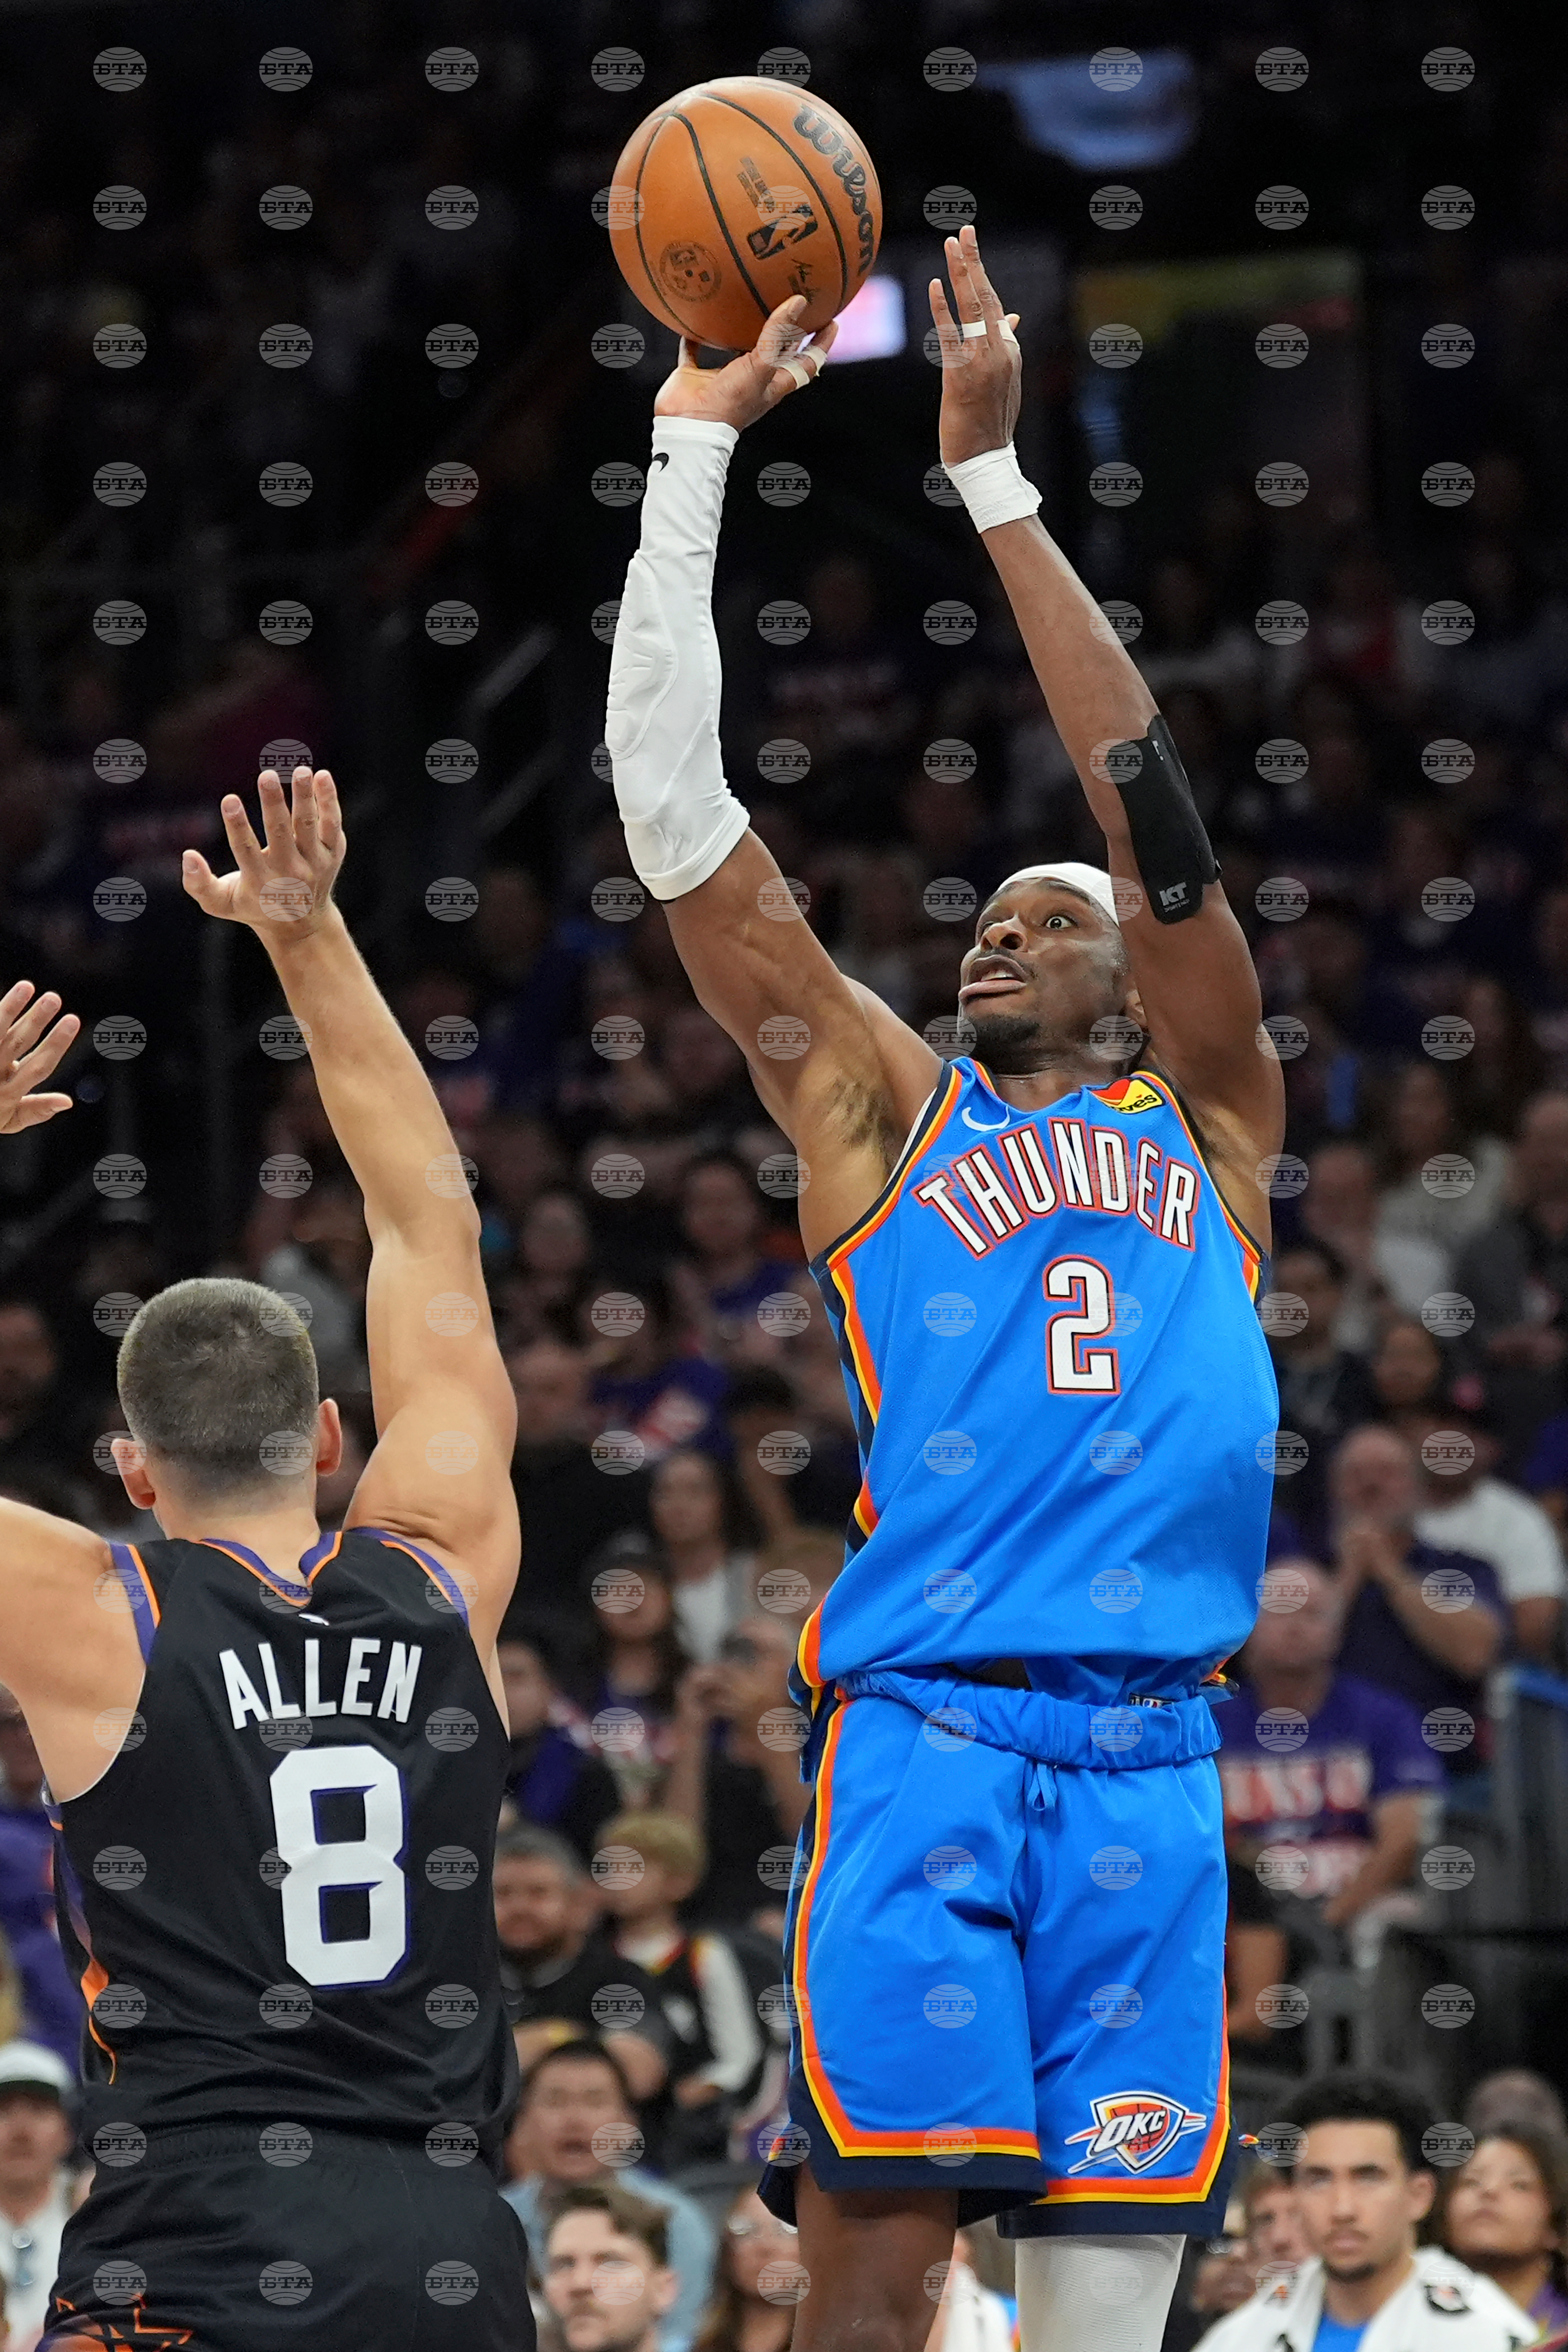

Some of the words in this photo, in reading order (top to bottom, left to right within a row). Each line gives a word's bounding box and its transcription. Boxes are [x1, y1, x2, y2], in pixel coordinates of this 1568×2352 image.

[912, 1118, 1199, 1260] THUNDER
[1043, 1254, 1121, 1395] 2
[219, 1638, 422, 1730] ALLEN
[269, 1746, 408, 1987] 8
[1093, 2110, 1167, 2153] OKC
